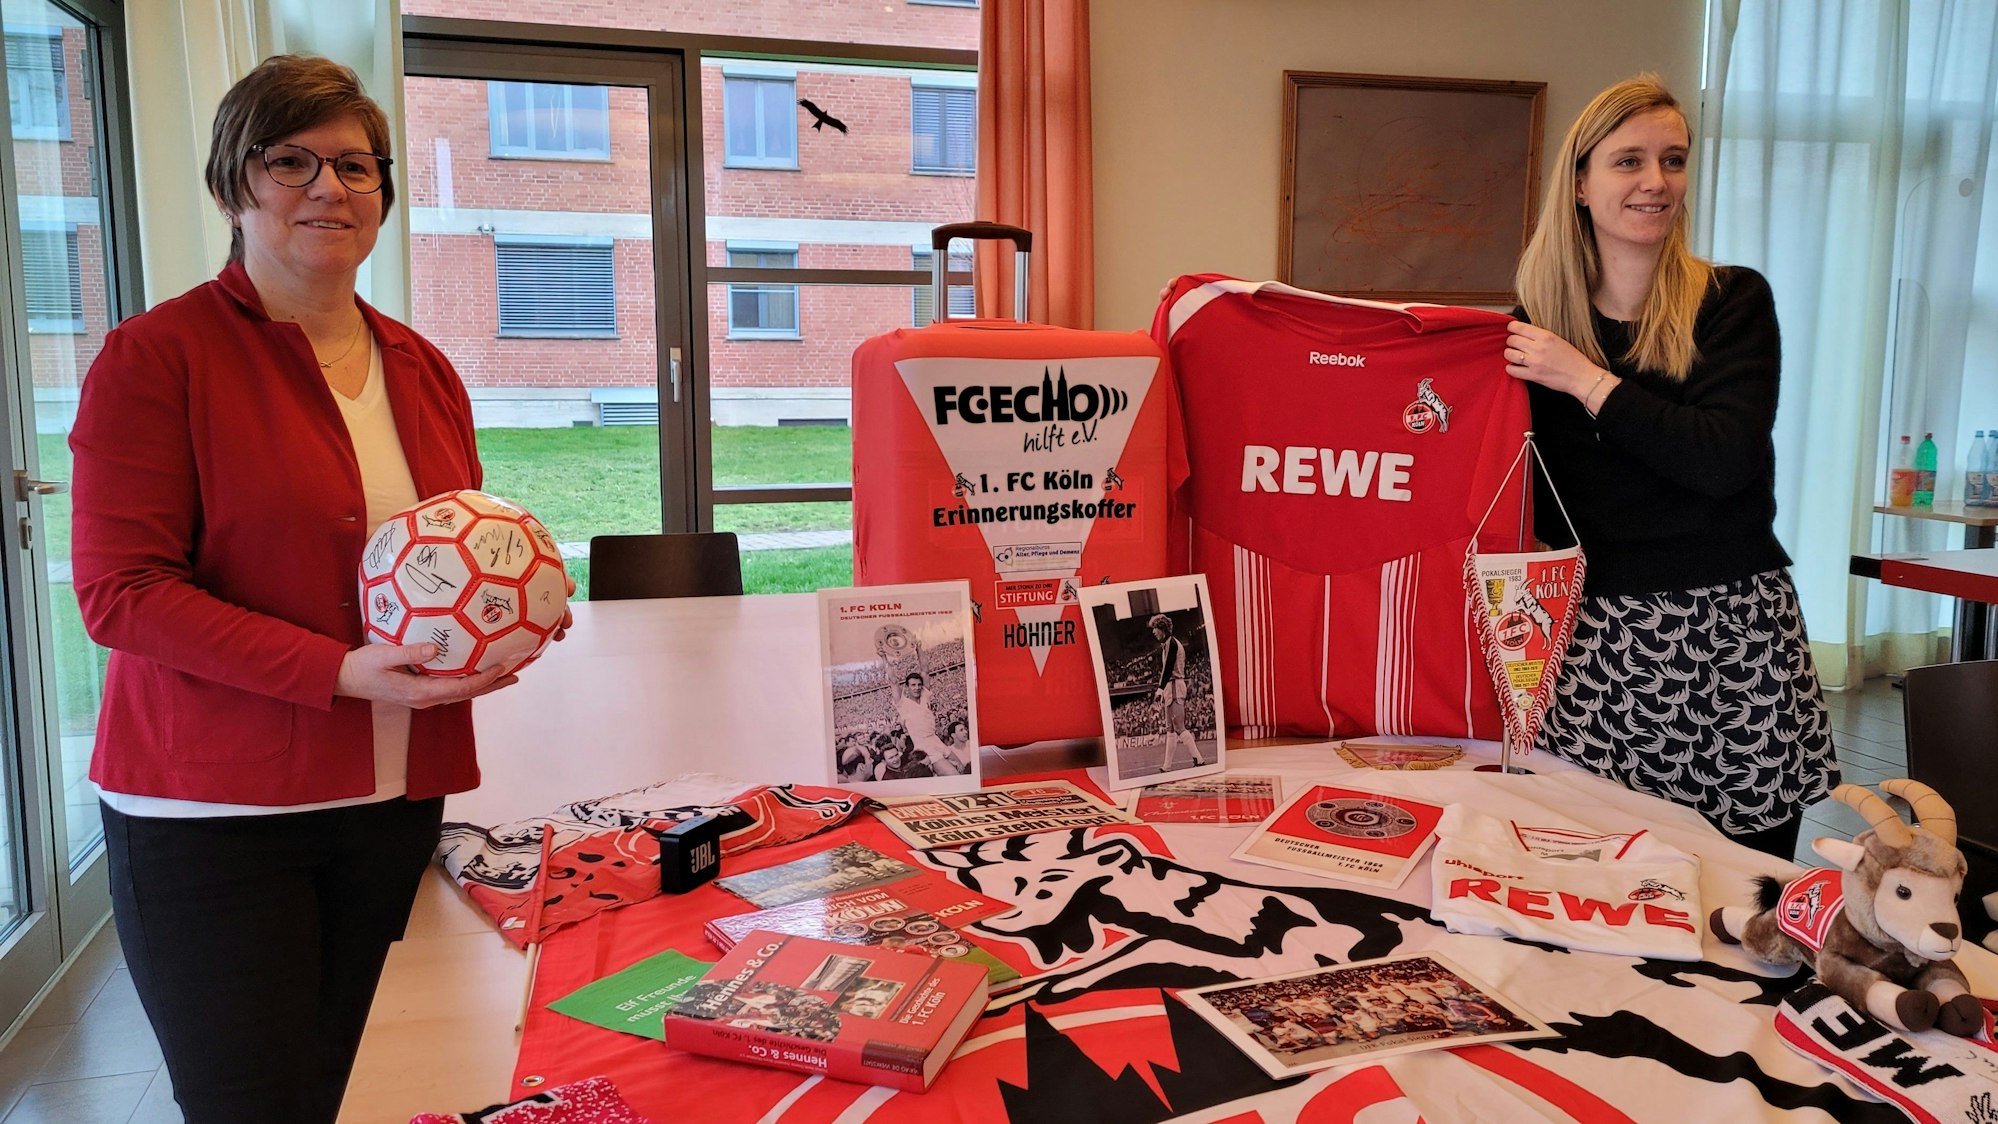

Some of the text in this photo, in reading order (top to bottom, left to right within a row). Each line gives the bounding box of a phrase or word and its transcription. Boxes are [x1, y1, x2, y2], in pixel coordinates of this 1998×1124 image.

[1309, 351, 1366, 367] Reebok
[1023, 419, 1097, 453] hilft e.V.
[980, 469, 1093, 493] 1. FC Köln
[1241, 445, 1414, 502] REWE
[933, 498, 1137, 527] Erinnerungskoffer
[1481, 569, 1522, 577] POKALSIEGER
[1000, 590, 1054, 603] STIFTUNG
[1535, 581, 1569, 600] KÖLN
[869, 602, 902, 611] KÖLN
[892, 803, 951, 818] EXPRESS
[904, 805, 1107, 833] Köln ist Meister!
[921, 829, 984, 844] Köln
[984, 820, 1054, 836] steht
[1275, 837, 1320, 850] DEUTSCHER
[695, 841, 716, 874] JBL
[1287, 846, 1384, 868] FUSSBALLMEISTER 1964
[1444, 859, 1524, 880] uhlsport
[857, 892, 890, 906] VOM
[1448, 878, 1696, 934] REWE
[826, 899, 907, 926] KÖLN
[701, 941, 783, 1010] Hennes & Co.
[615, 975, 697, 1012] Elf Freunde
[898, 977, 941, 1024] Die Geschichte des
[925, 991, 946, 1008] Köln
[917, 1007, 934, 1018] FC
[712, 1029, 731, 1039] Köln
[732, 1032, 743, 1040] FC
[753, 1036, 767, 1044] des
[748, 1044, 768, 1057] Co.
[768, 1040, 812, 1053] Geschichte
[770, 1048, 780, 1059] &
[812, 1046, 827, 1054] Die
[783, 1049, 828, 1068] Hennes
